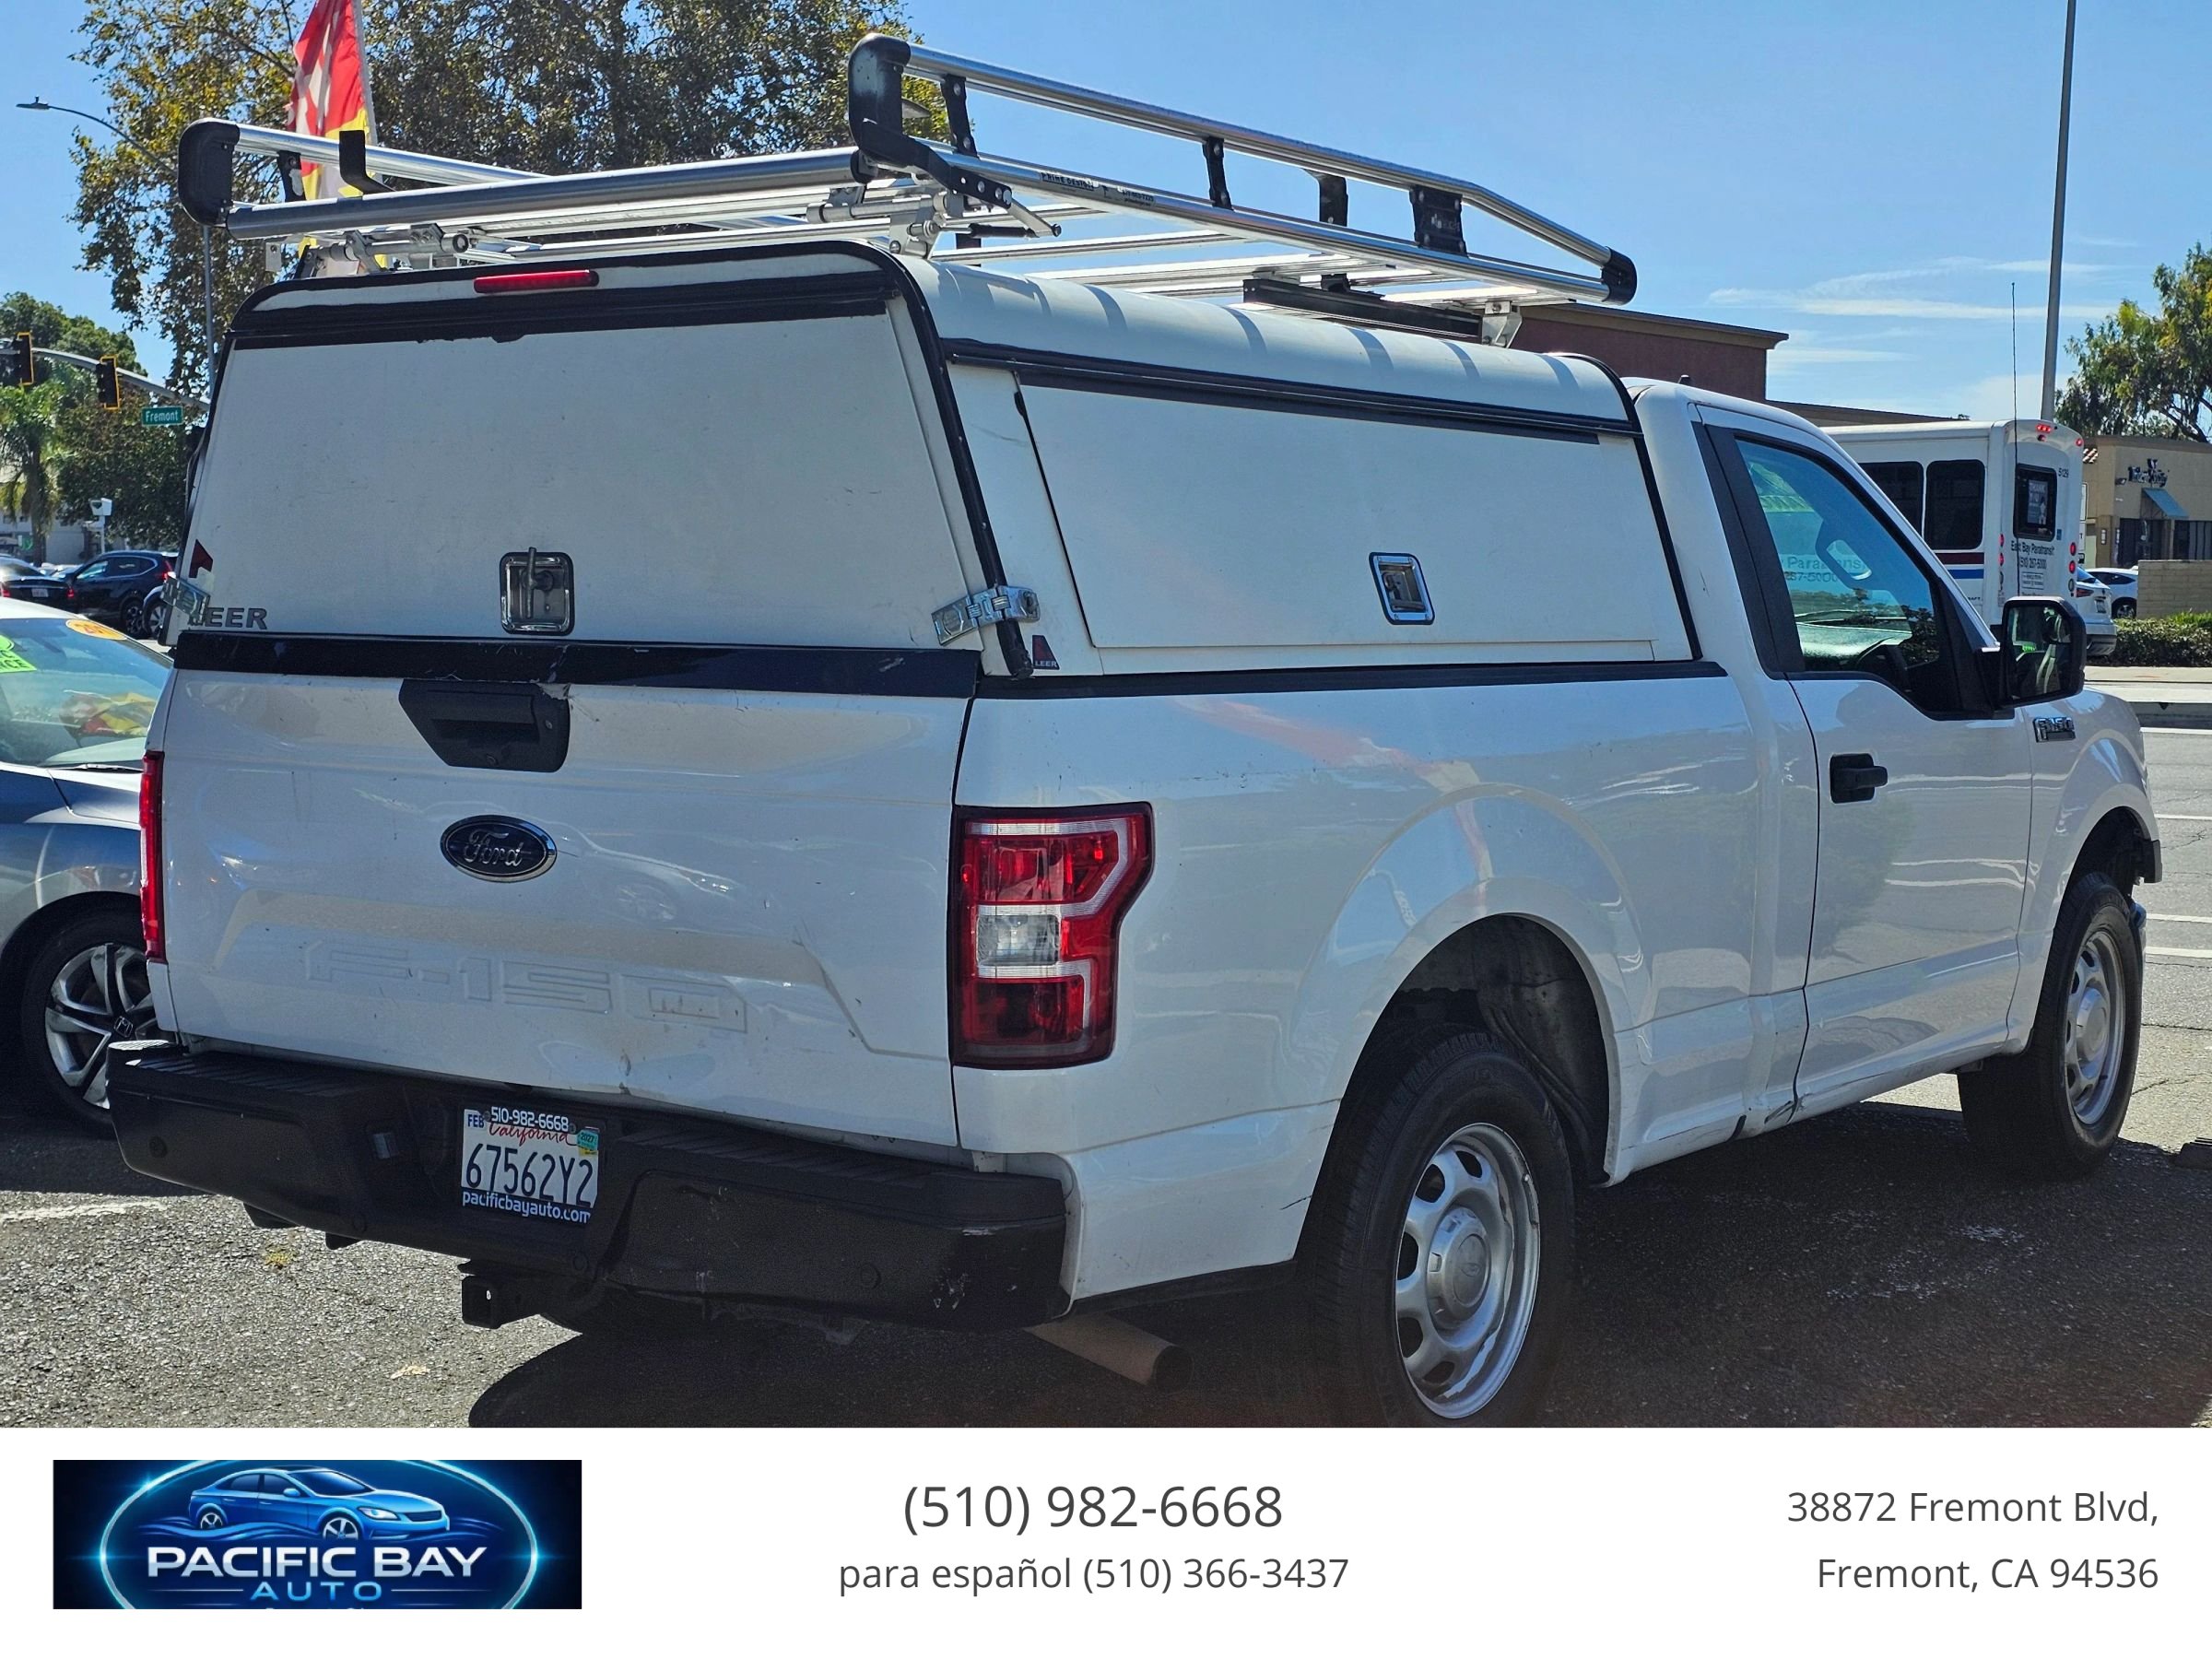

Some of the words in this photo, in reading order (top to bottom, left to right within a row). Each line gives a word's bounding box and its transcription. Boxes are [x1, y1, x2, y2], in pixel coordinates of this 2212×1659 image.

[145, 410, 179, 422] Fremont
[204, 607, 267, 629] EER
[1035, 660, 1057, 668] LEER
[464, 829, 524, 866] Ford
[305, 940, 748, 1034] F-150
[467, 1113, 485, 1128] FEB
[490, 1106, 569, 1133] 510-982-6668
[466, 1144, 593, 1208] 67562Y2
[463, 1192, 591, 1224] pacificbayauto.com
